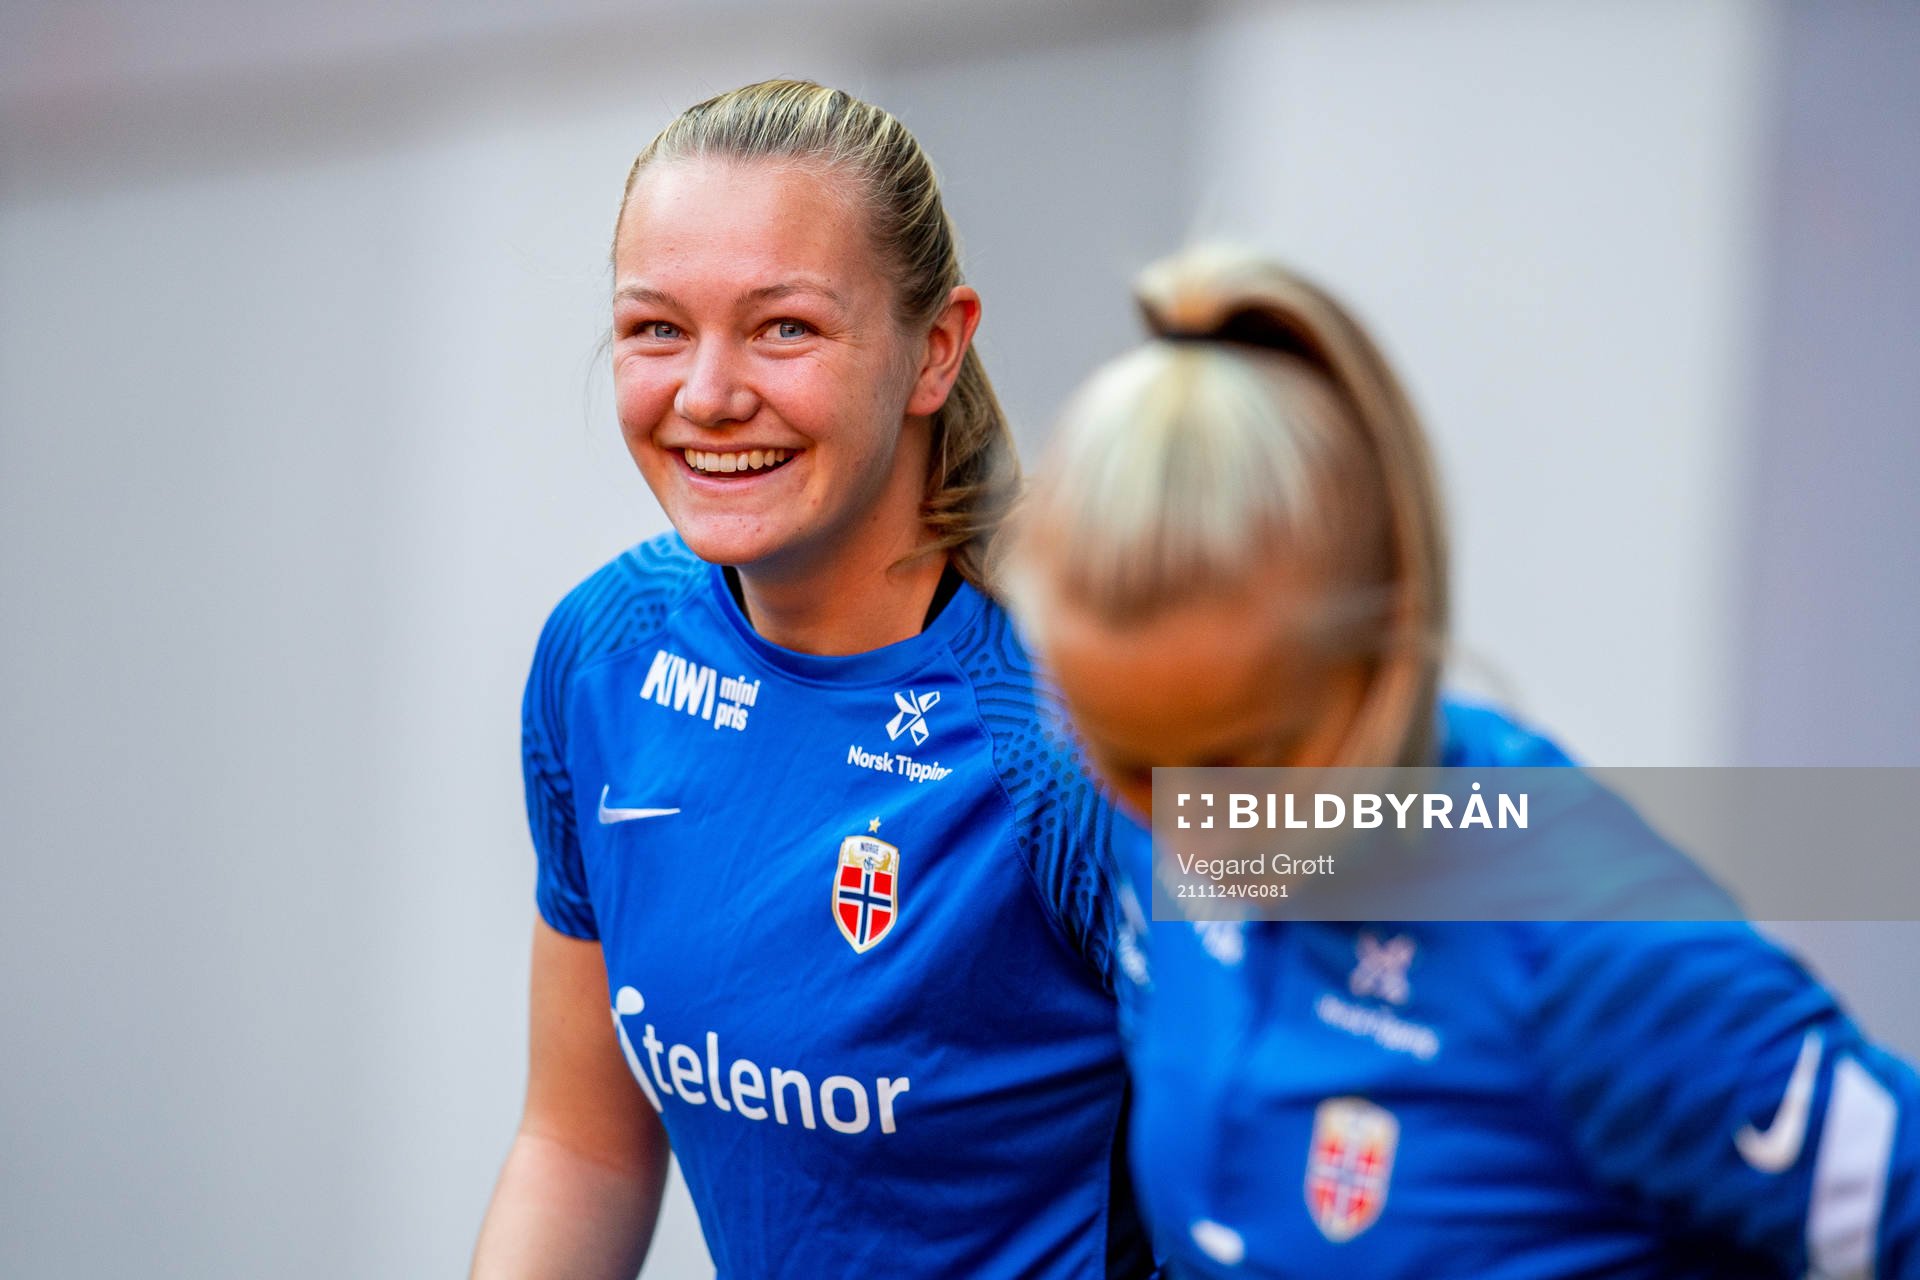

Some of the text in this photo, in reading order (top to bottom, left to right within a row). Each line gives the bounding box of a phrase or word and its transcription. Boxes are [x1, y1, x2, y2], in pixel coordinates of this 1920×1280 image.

[640, 650, 717, 720] KIWI
[720, 675, 760, 707] mini
[714, 702, 748, 731] pris
[847, 744, 894, 773] Norsk
[642, 1023, 910, 1134] telenor
